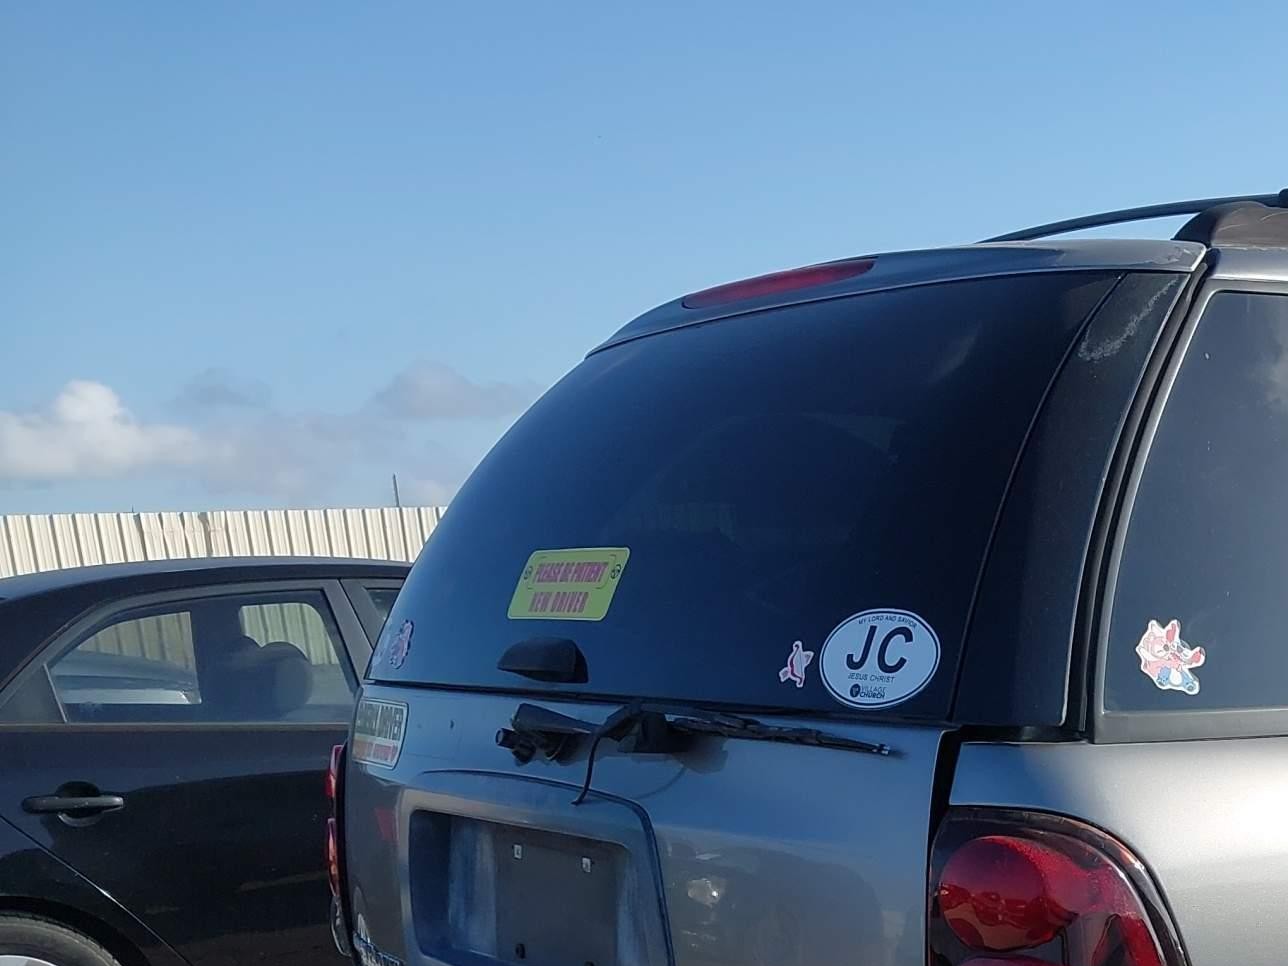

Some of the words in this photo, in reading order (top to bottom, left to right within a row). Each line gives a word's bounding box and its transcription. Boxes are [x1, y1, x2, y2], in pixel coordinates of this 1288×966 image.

[533, 562, 564, 582] PLEASE
[528, 592, 552, 613] NEW
[550, 592, 589, 613] DRIVER
[846, 625, 914, 674] JC
[847, 672, 868, 681] JESUS
[869, 674, 896, 684] CHRIST
[859, 691, 886, 700] CHURCH
[860, 685, 887, 693] VILLAGE
